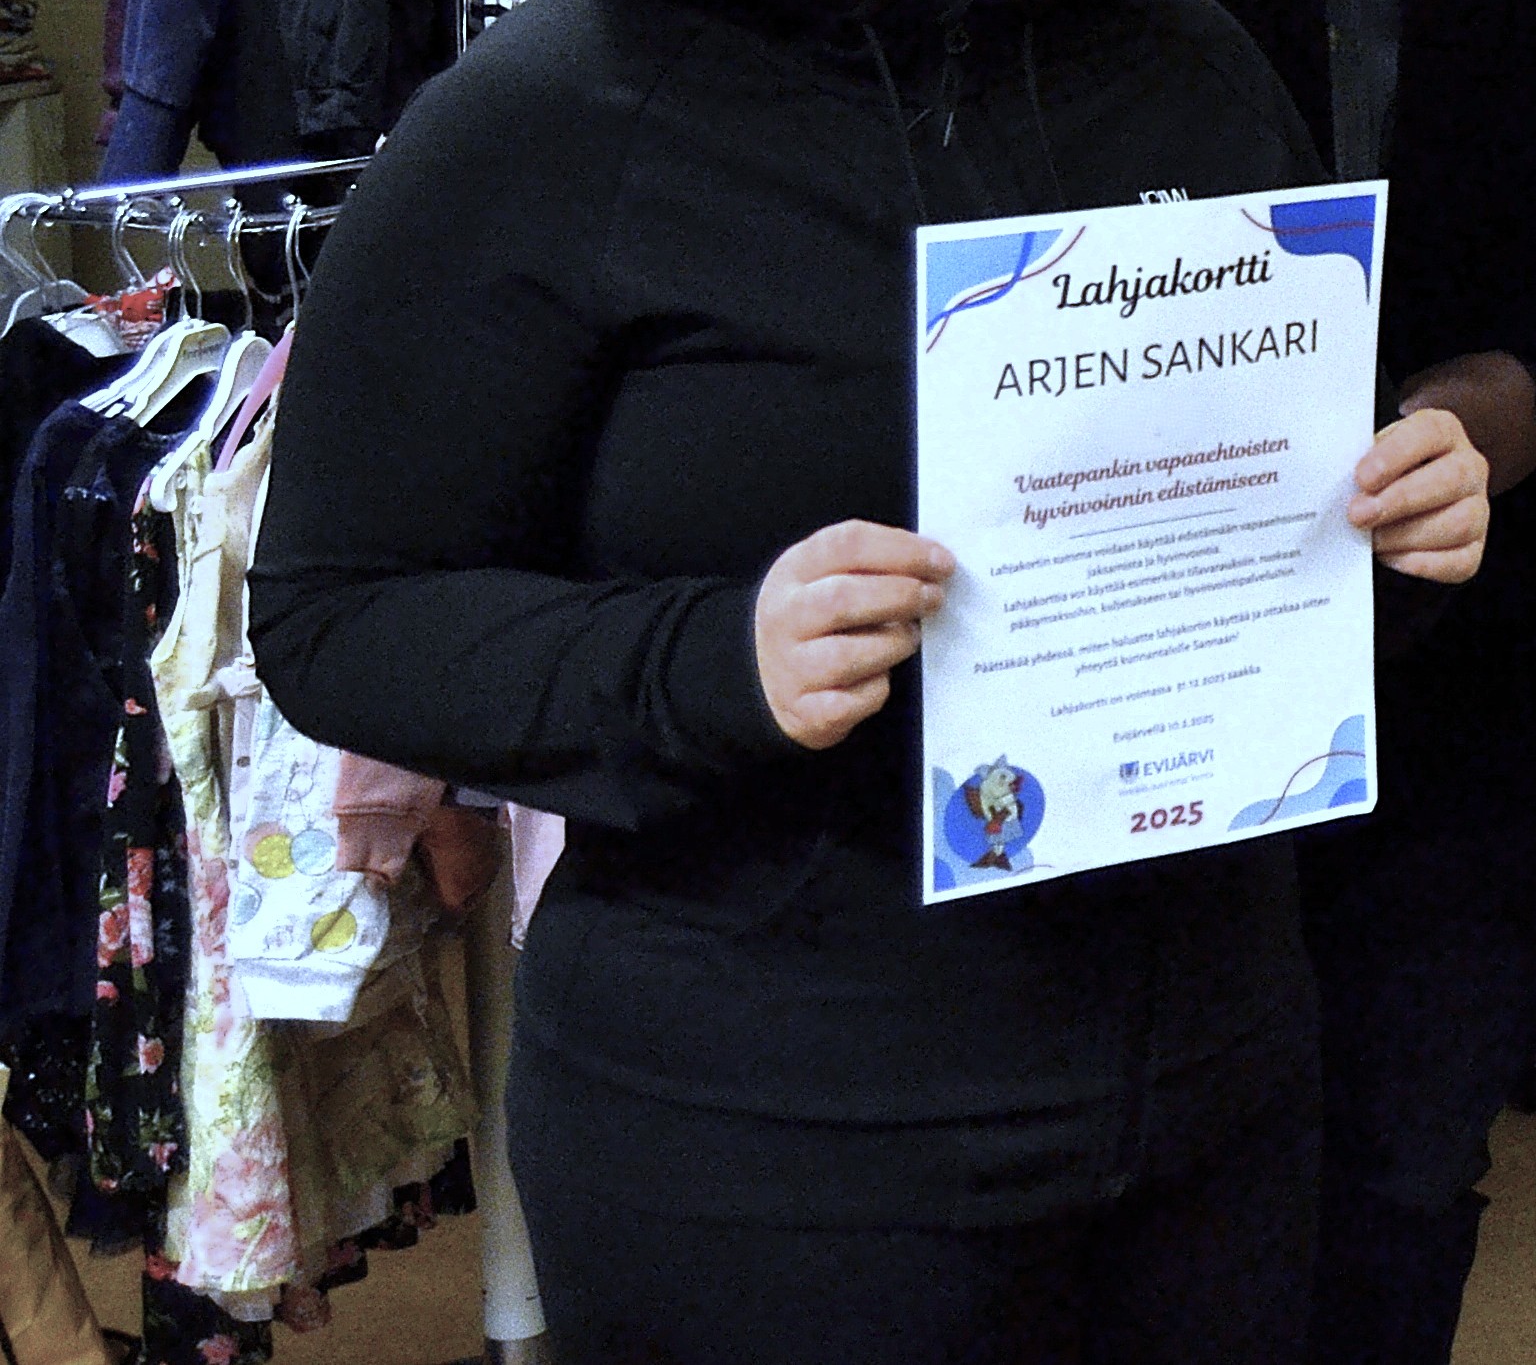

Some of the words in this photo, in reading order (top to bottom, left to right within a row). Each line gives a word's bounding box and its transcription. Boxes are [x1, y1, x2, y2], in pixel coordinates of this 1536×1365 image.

[1052, 250, 1273, 318] Lahjakortti
[994, 348, 1129, 400] ARJEN
[1142, 319, 1318, 380] SANKARI
[1014, 457, 1142, 495] Vaatepankin
[1146, 436, 1290, 476] vapaaehtoisten
[1022, 486, 1154, 530] hyvinvoinnin
[1158, 469, 1280, 502] edistämiseen
[1143, 748, 1214, 777] EVIJÄRVI
[1130, 800, 1204, 834] 2025
